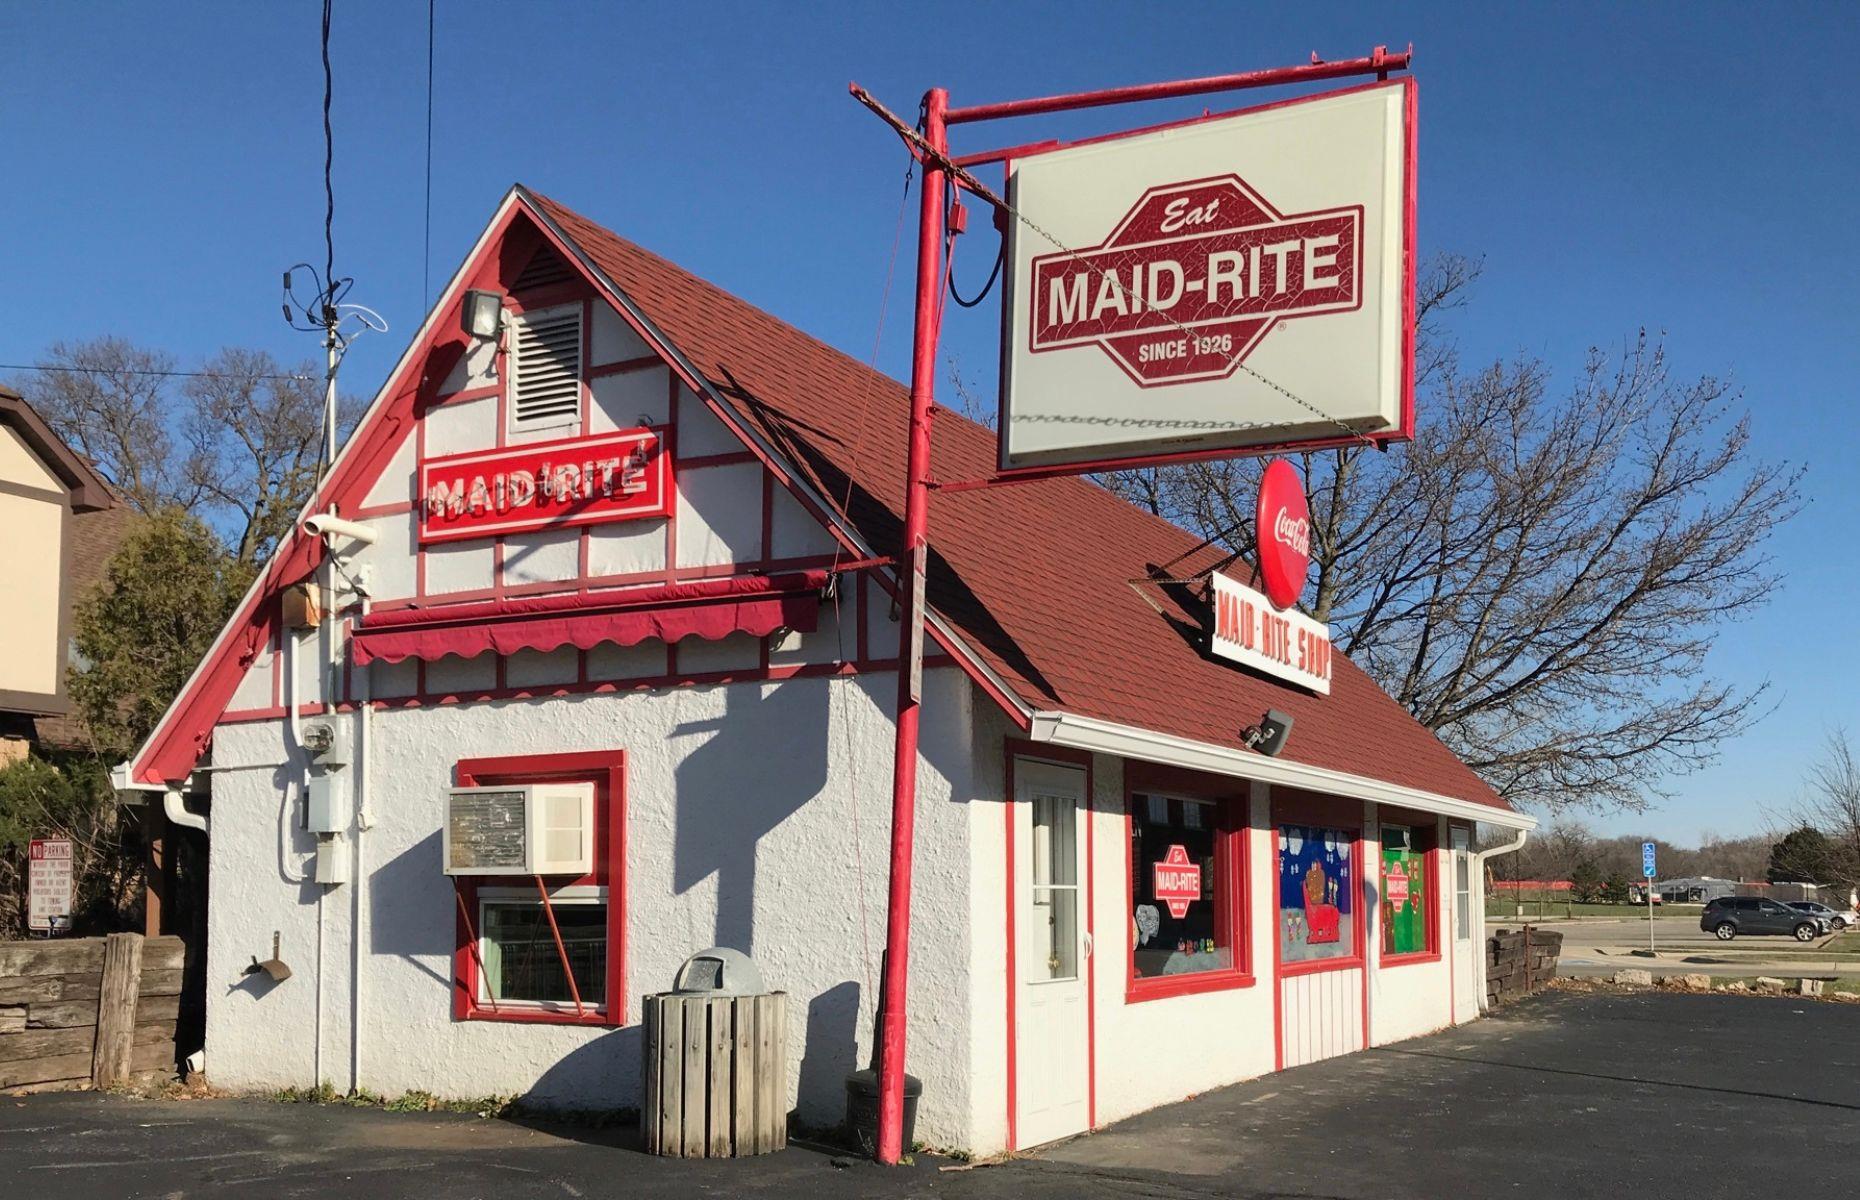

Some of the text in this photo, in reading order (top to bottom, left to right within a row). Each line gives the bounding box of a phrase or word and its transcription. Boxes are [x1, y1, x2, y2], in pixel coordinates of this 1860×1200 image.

[1160, 197, 1220, 233] Eat
[1048, 234, 1340, 326] MAID-RITE
[1138, 334, 1233, 363] SINCE 1926
[1217, 589, 1330, 680] MAID RITE SHOP
[32, 845, 70, 858] NO PARKING
[1158, 871, 1198, 891] MAID-RITE
